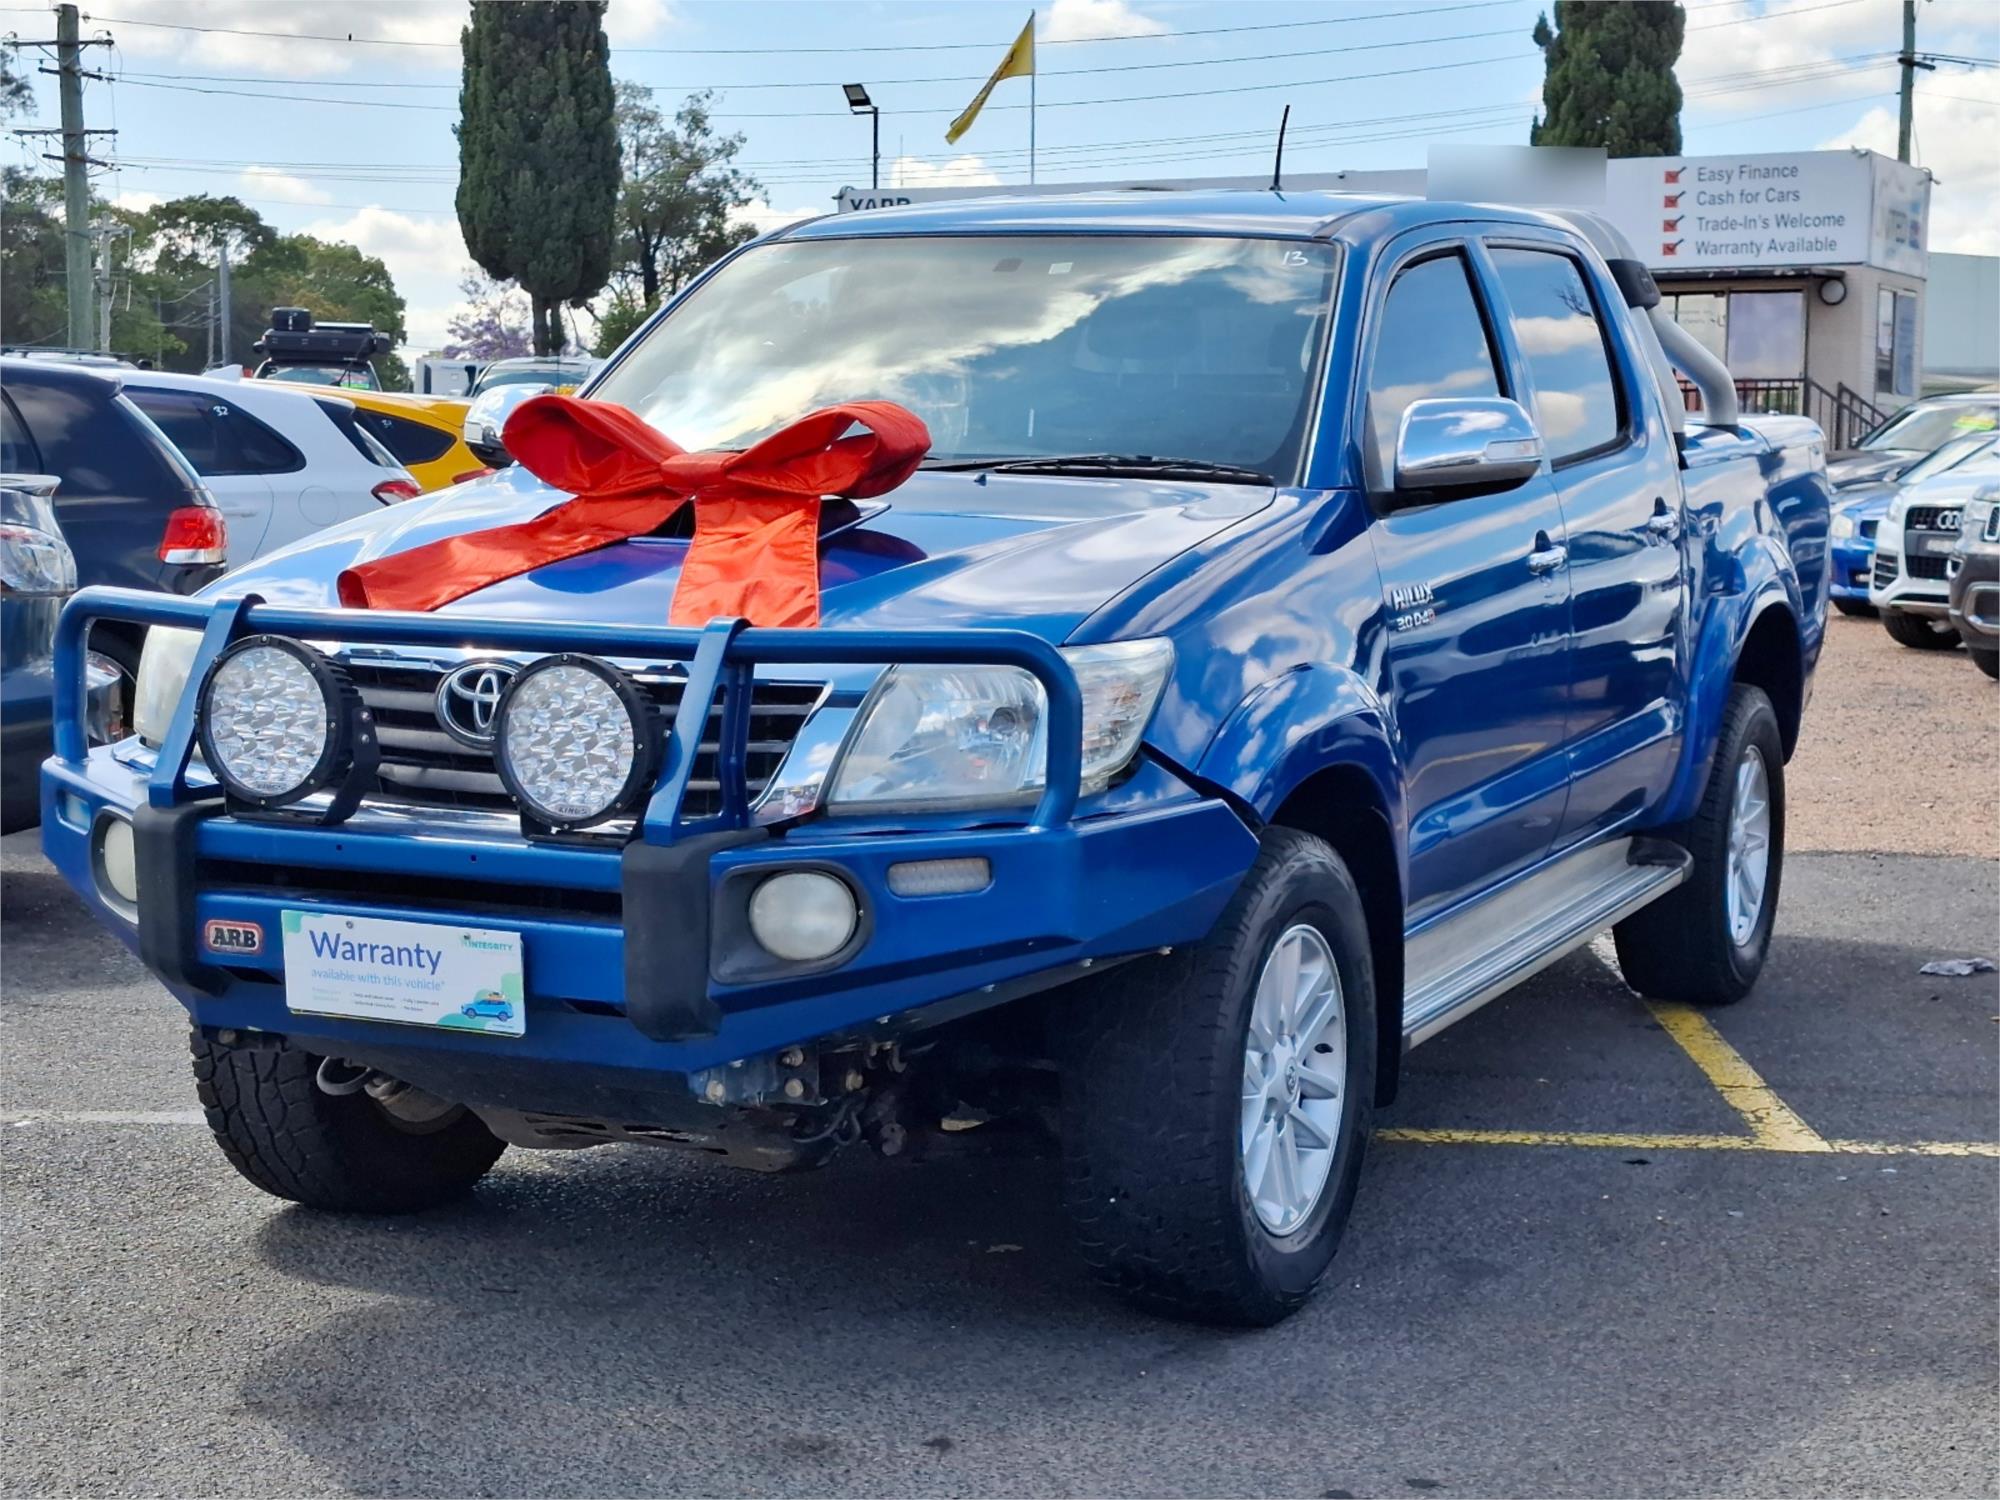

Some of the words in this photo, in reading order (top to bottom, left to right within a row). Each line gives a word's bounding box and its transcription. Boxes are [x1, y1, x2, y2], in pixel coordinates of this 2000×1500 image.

[1697, 166, 1734, 184] Easy
[1738, 164, 1799, 180] Finance
[1696, 190, 1735, 206] Cash
[1739, 188, 1761, 204] for
[1765, 187, 1801, 203] Cars
[1696, 215, 1770, 232] Trade-In's
[1774, 212, 1846, 229] Welcome
[1695, 239, 1763, 258] Warranty
[1767, 236, 1837, 252] Available
[1281, 250, 1309, 267] 13
[212, 405, 229, 417] 32
[1391, 583, 1434, 611] HILUX
[212, 927, 257, 948] ARB
[309, 929, 442, 976] Warranty
[311, 968, 356, 983] available
[358, 973, 381, 985] with
[382, 974, 402, 988] this
